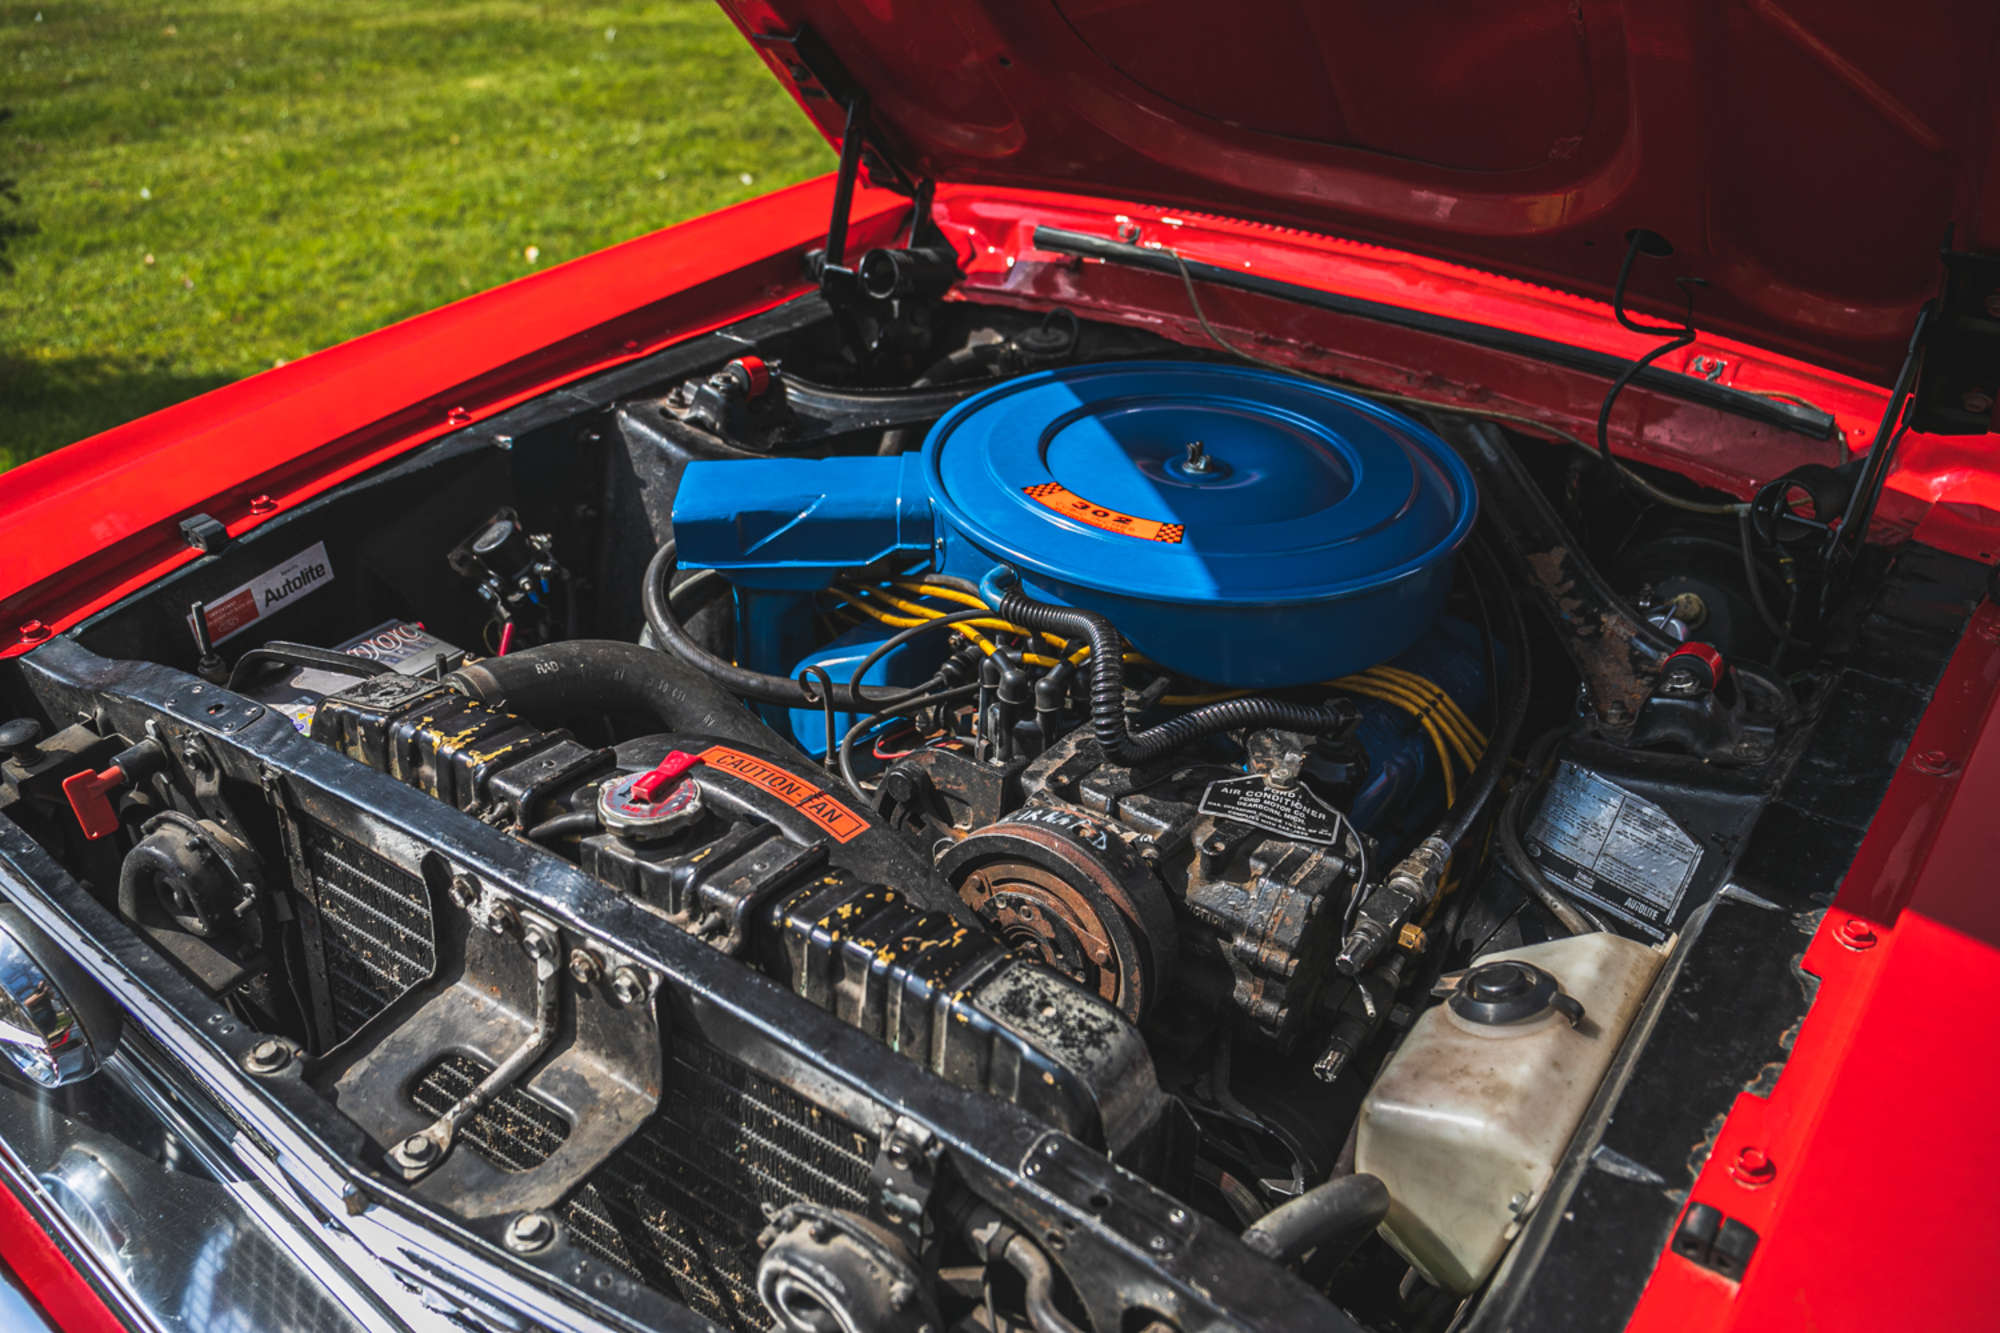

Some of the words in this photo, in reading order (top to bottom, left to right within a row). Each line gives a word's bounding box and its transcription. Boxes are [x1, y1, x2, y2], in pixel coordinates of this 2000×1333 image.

[264, 563, 326, 608] Autolite
[1221, 787, 1241, 795] AIR
[1246, 790, 1326, 820] CONDITIONER
[1263, 799, 1292, 813] MOTOR
[1624, 896, 1660, 921] AUTOLITE
